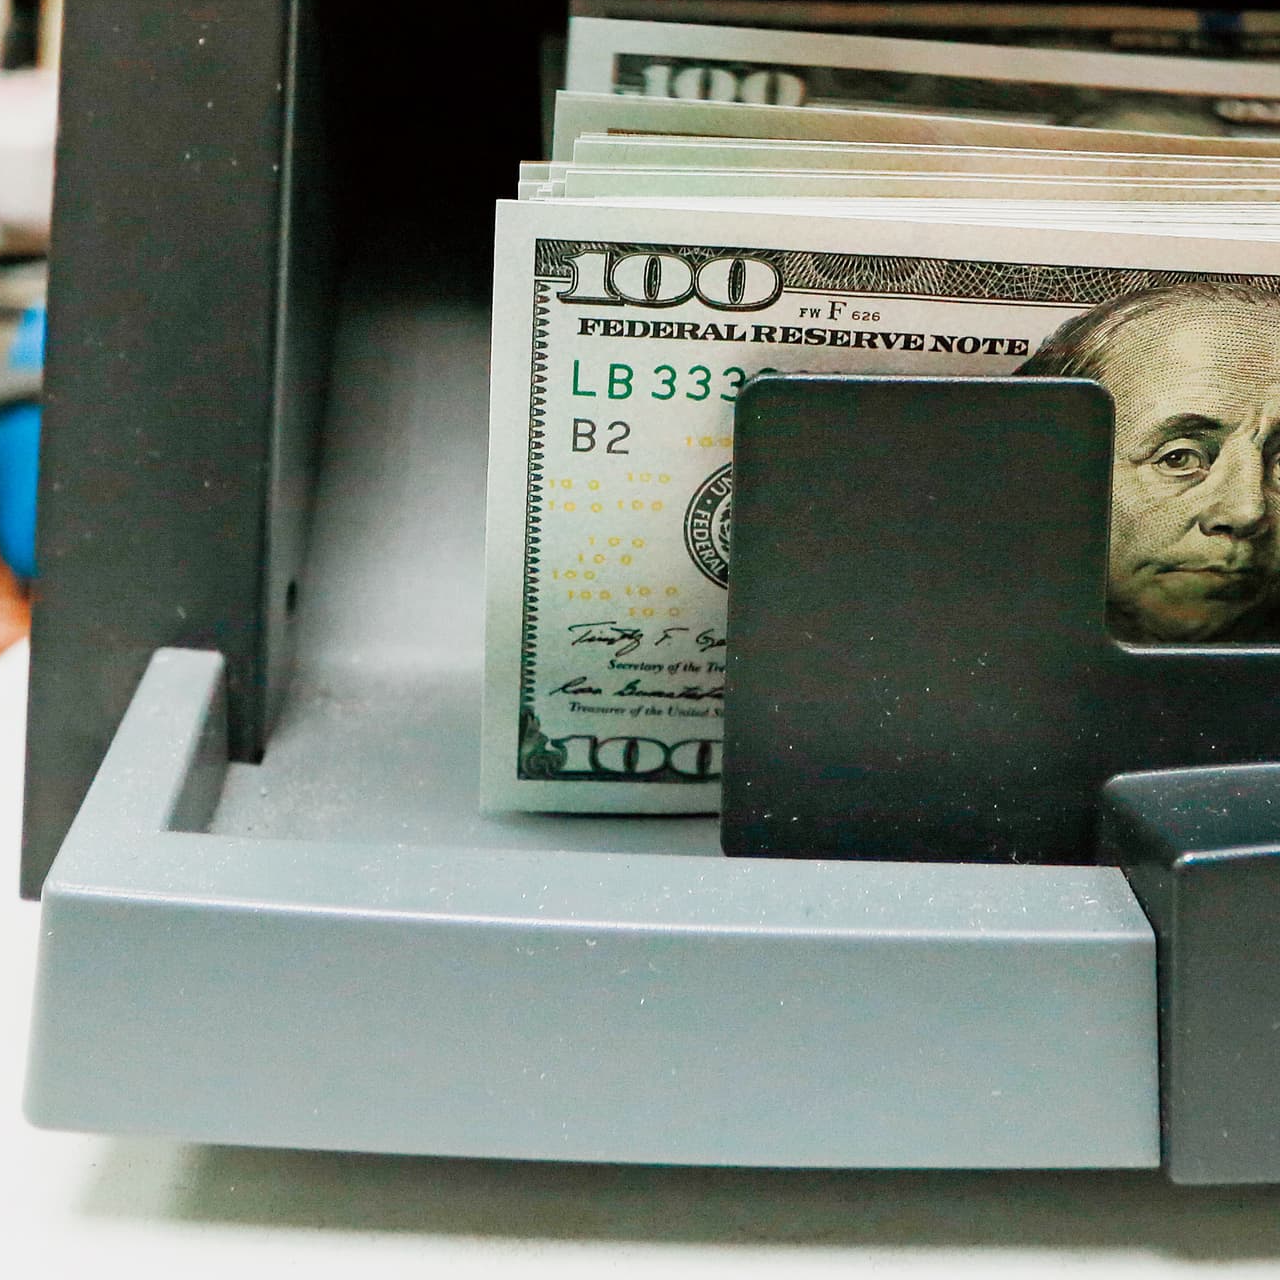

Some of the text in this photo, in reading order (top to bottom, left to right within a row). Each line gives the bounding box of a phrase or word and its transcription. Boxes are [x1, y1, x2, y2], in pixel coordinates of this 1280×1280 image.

[556, 251, 784, 312] 100
[799, 300, 881, 322] FW F 626
[577, 317, 1029, 357] FEDERAL RESERVE NOTE
[571, 417, 632, 455] B2
[693, 508, 726, 576] FEDERAL
[608, 658, 663, 676] Secretary
[670, 661, 683, 675] of
[684, 660, 701, 671] the
[570, 701, 626, 714] Treasurer
[630, 704, 644, 717] of
[645, 705, 663, 716] the
